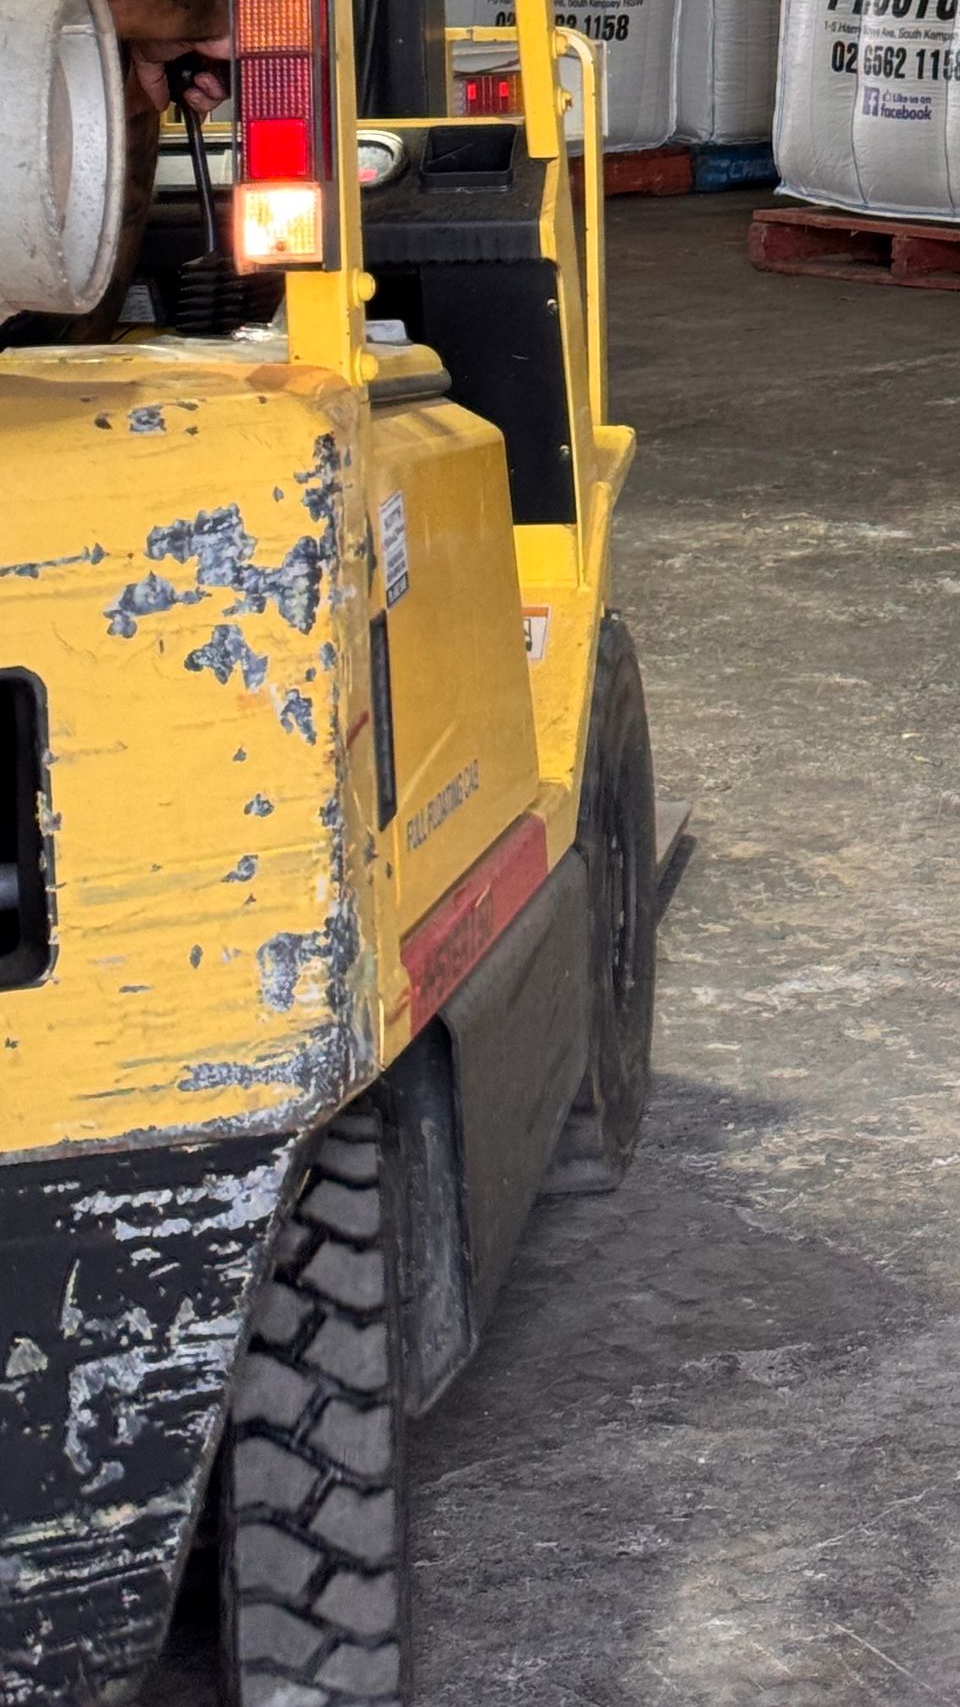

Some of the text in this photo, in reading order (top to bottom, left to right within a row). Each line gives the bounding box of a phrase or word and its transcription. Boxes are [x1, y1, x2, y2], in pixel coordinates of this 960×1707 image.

[584, 14, 629, 41] 1158
[831, 41, 859, 73] 02
[864, 45, 907, 79] 6562
[880, 103, 932, 120] facebook
